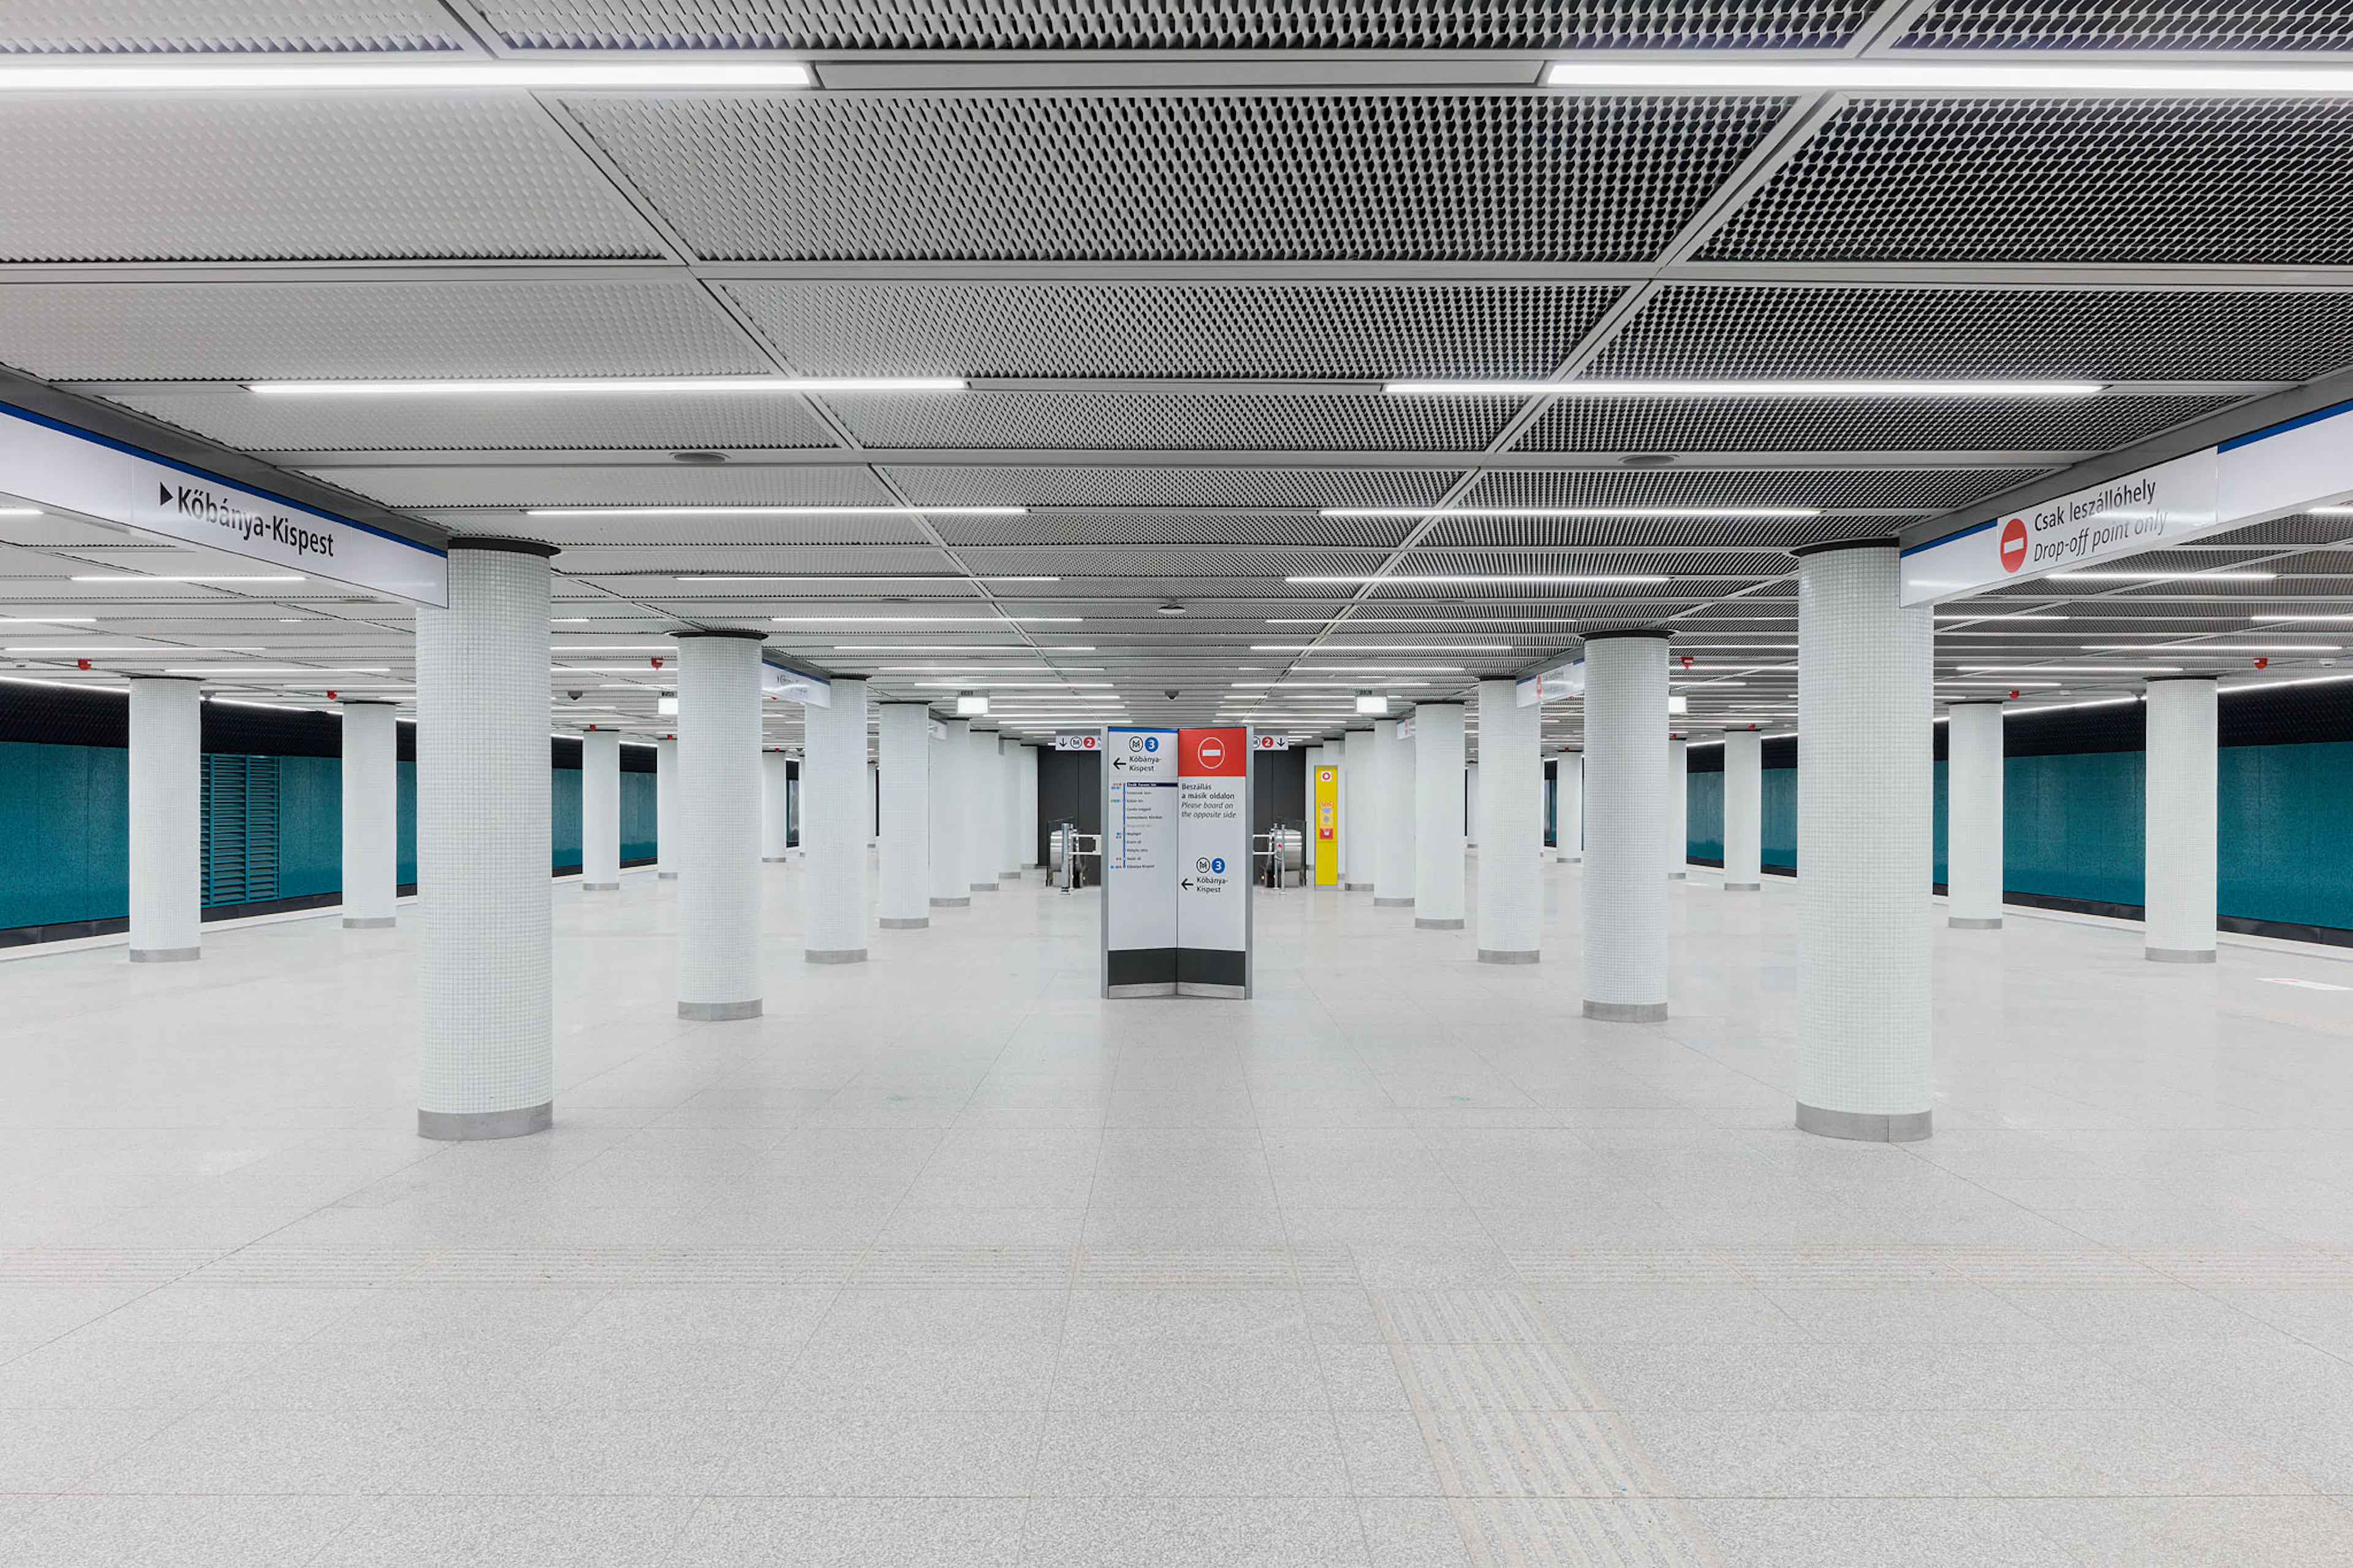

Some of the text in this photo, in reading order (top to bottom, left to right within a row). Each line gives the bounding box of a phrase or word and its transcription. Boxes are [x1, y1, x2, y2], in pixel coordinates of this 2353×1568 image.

[178, 485, 334, 557] Kőbánya-Kispest
[2034, 478, 2156, 531] Csak leszállóhely
[2034, 508, 2169, 562] Drop-off point only
[1197, 885, 1221, 894] Kispest
